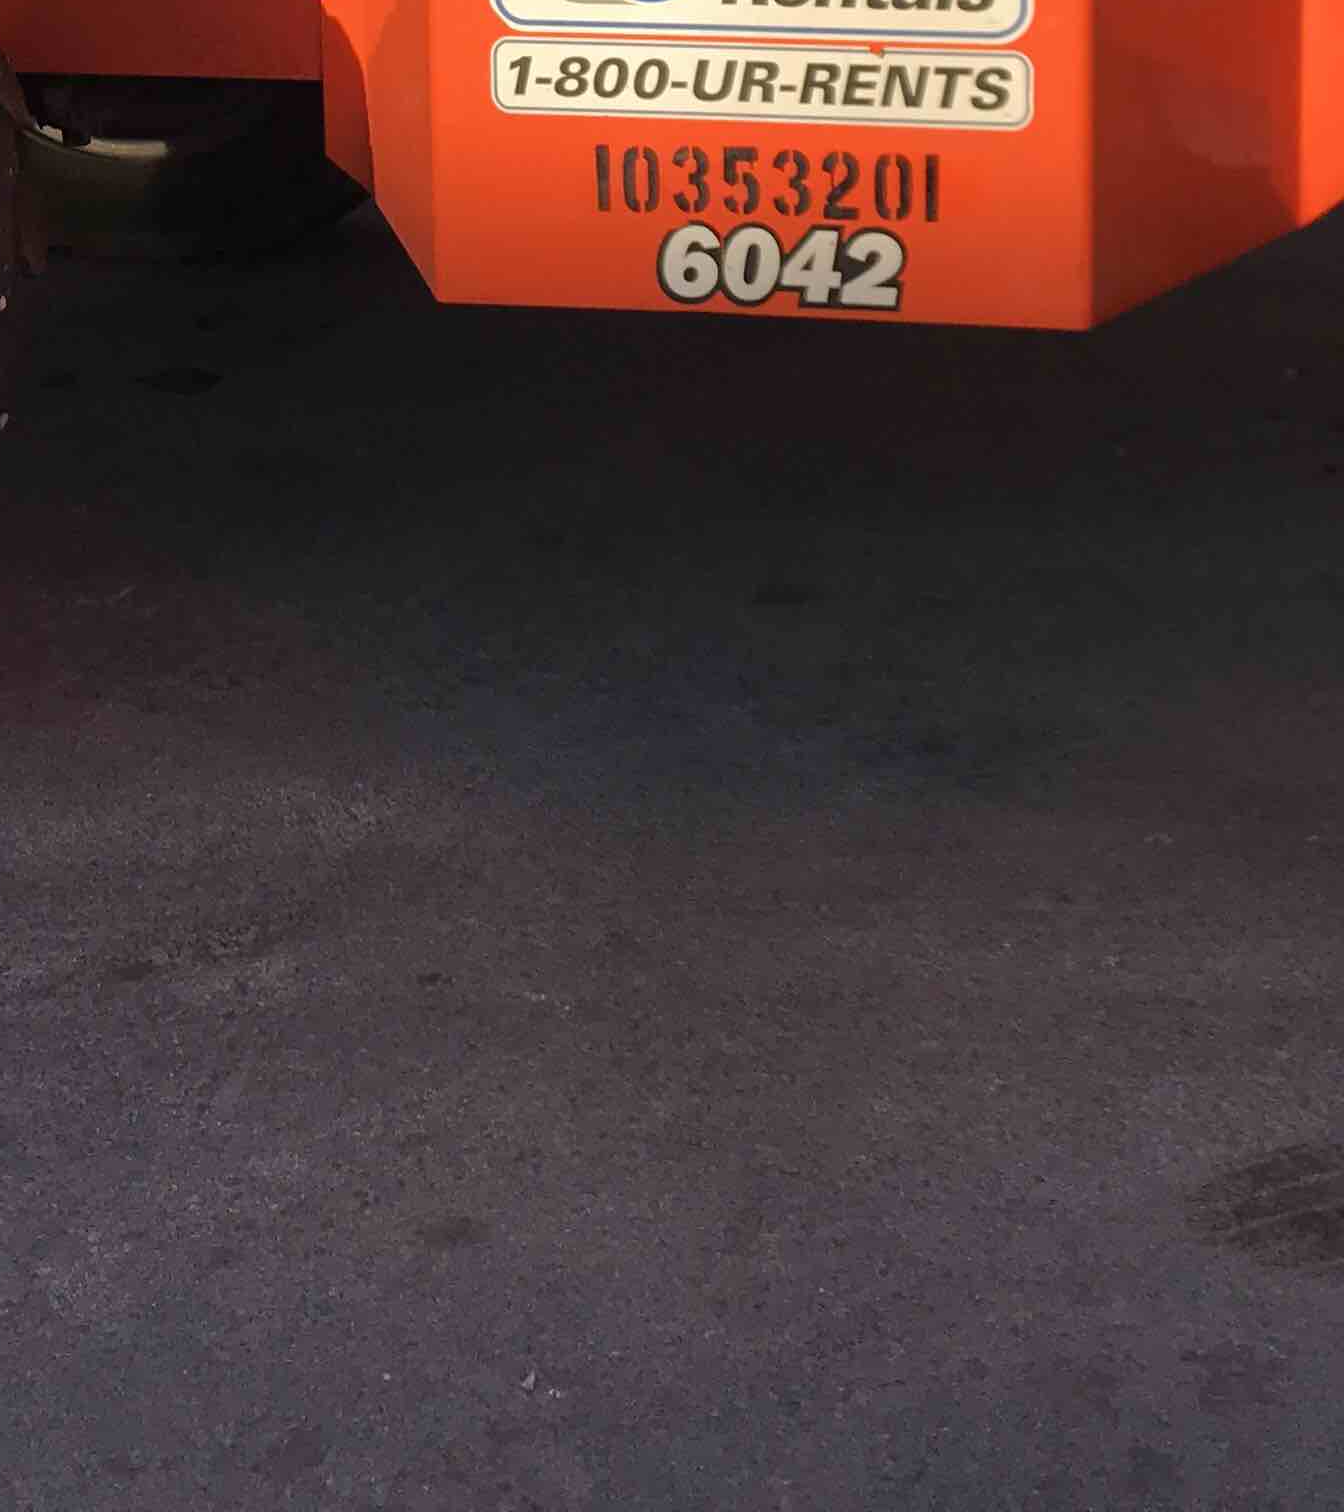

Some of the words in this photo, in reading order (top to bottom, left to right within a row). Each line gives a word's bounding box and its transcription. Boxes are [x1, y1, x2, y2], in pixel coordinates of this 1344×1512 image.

[506, 54, 1013, 112] 1-800-UR-RENTS
[594, 143, 940, 223] 10353201
[657, 221, 908, 312] 6042
